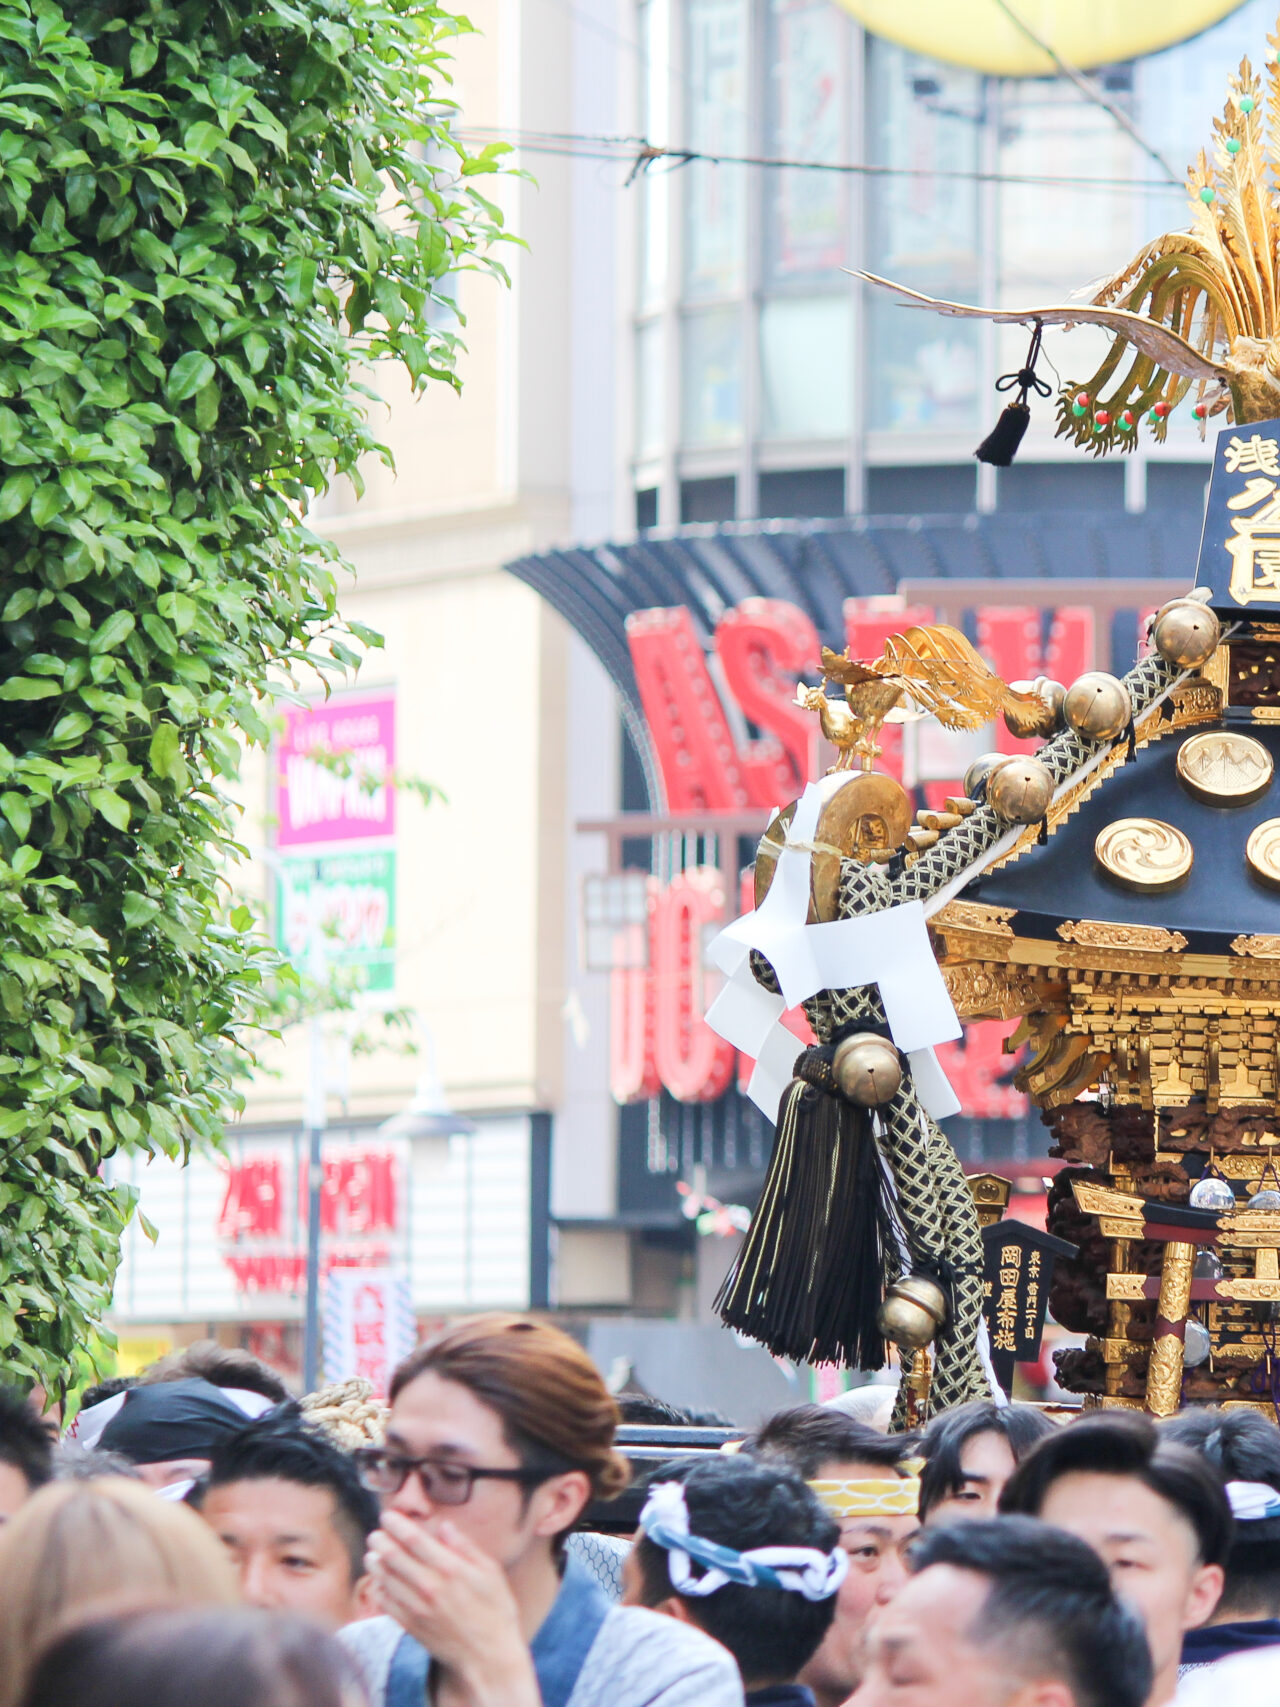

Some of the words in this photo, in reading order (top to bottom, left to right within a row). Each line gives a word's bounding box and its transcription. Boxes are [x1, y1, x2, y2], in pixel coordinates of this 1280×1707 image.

[993, 1245, 1022, 1351] 岡田屋布施
